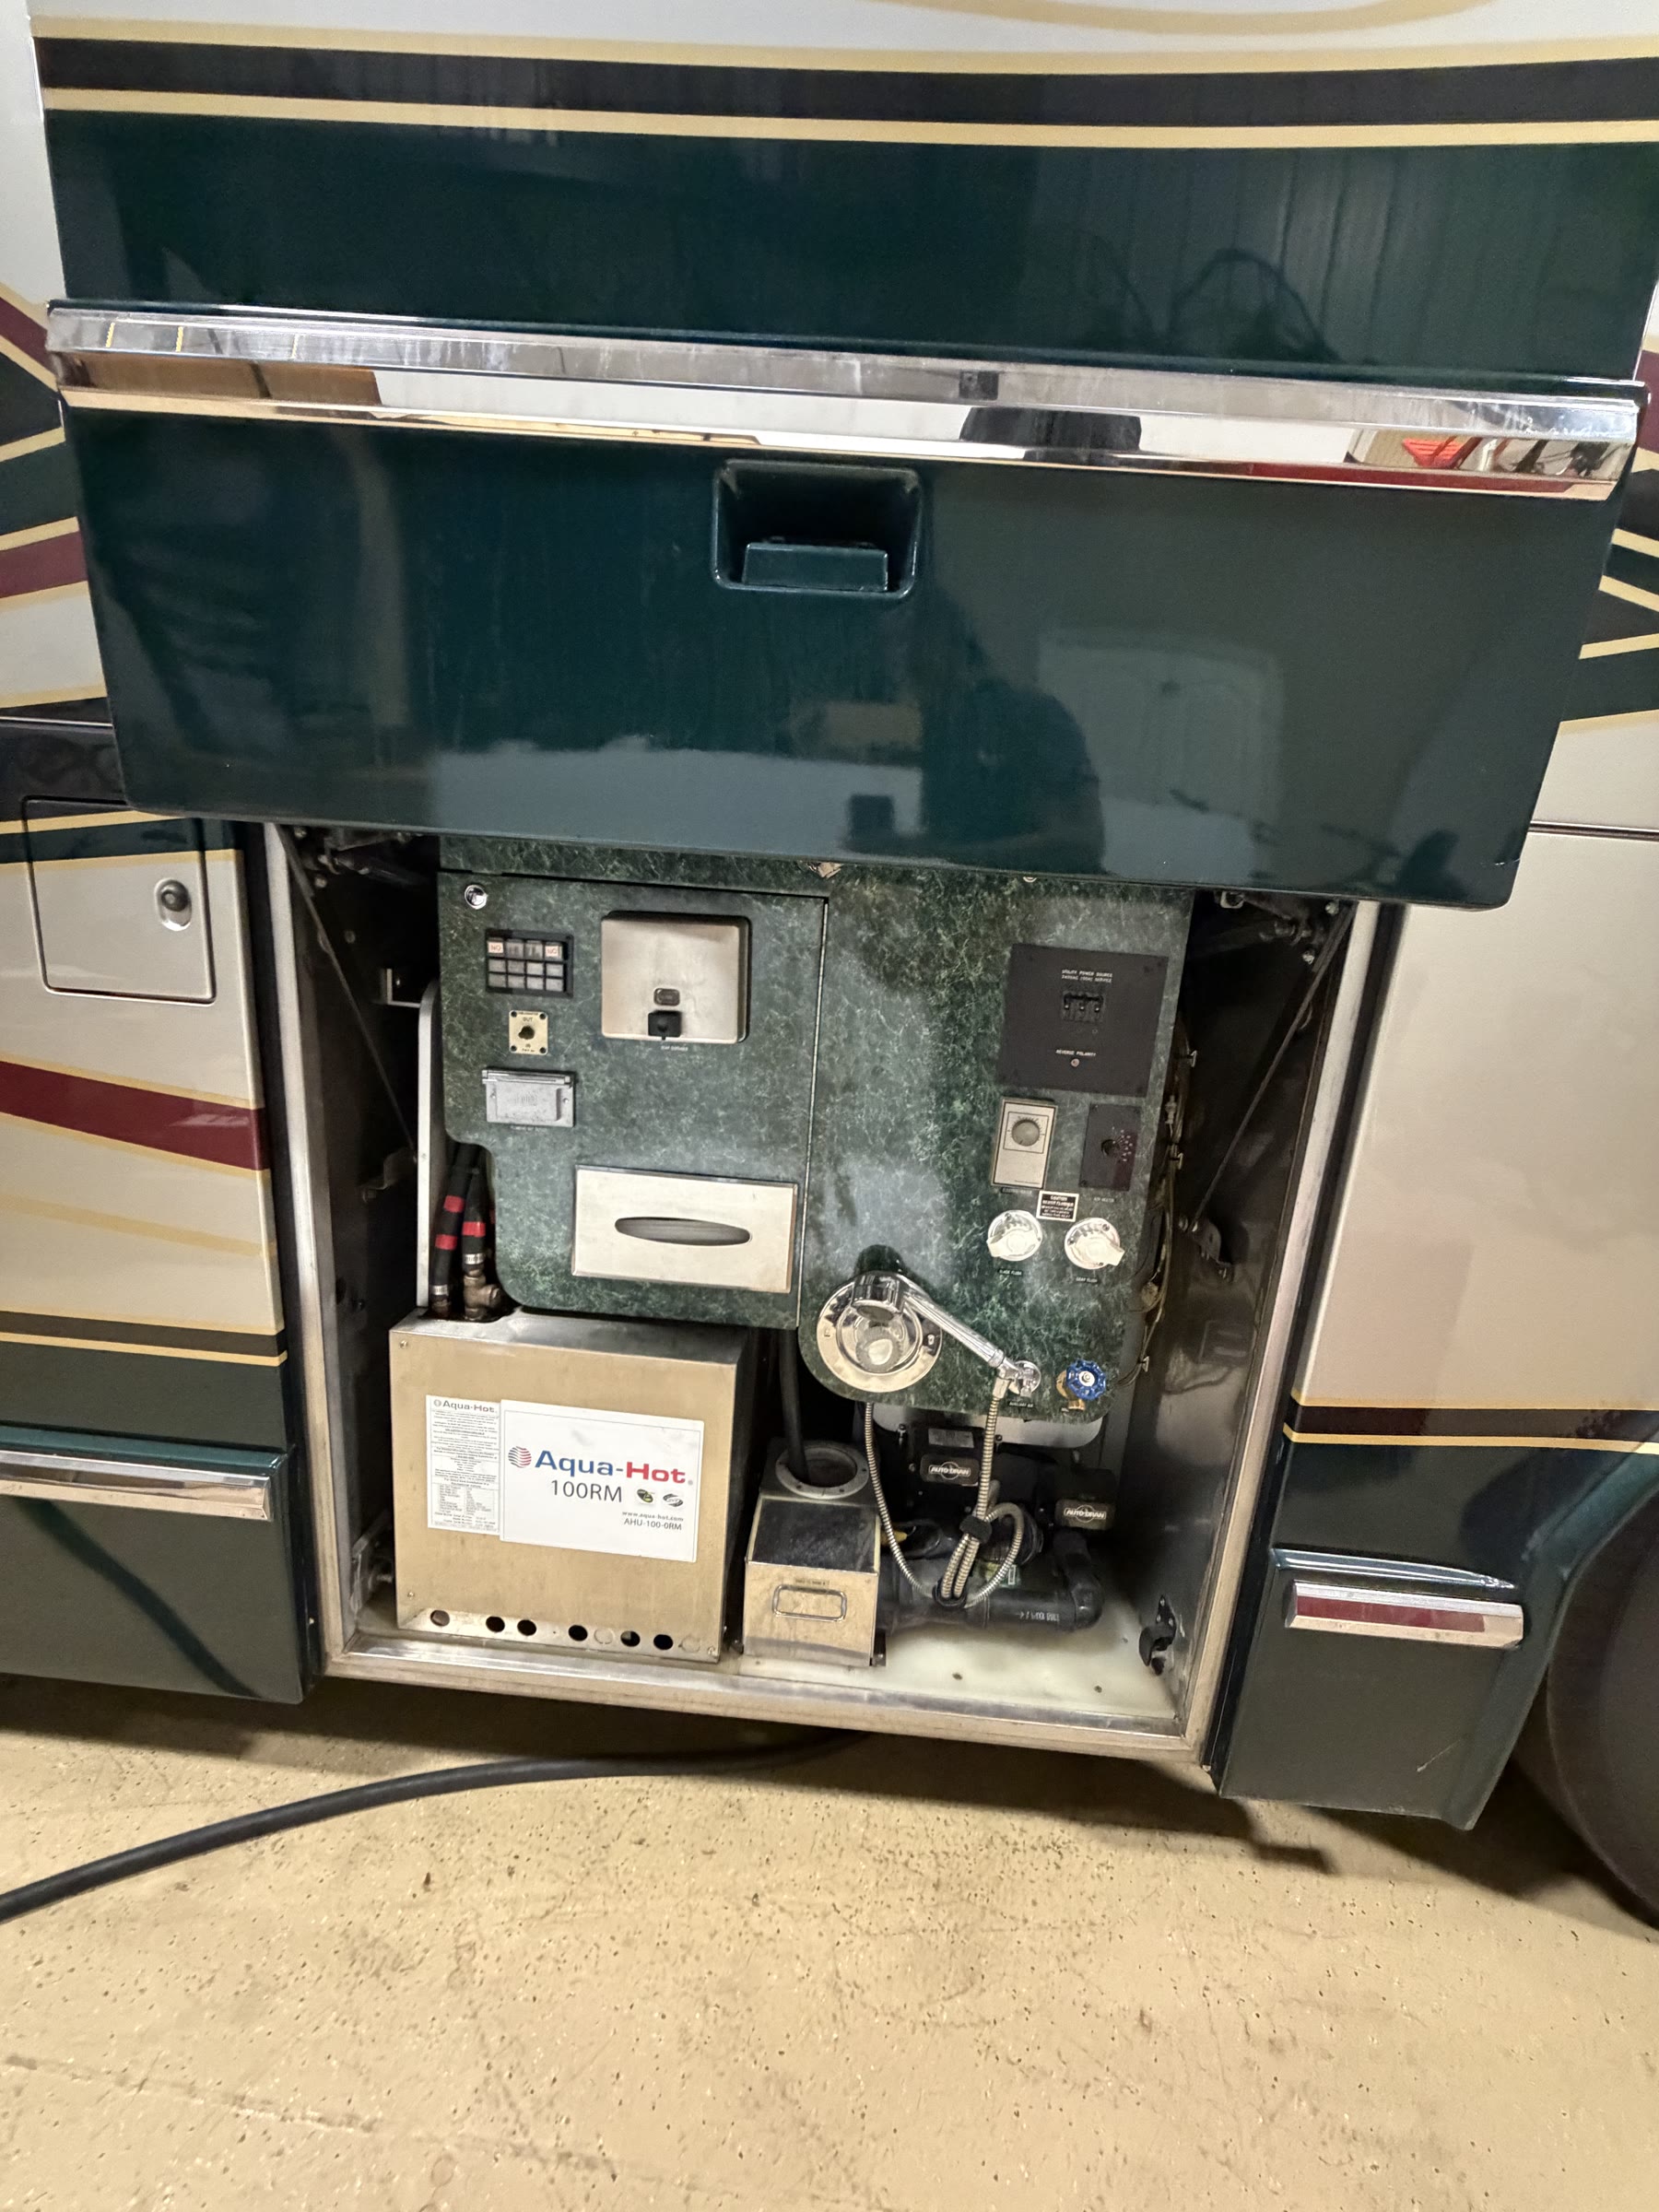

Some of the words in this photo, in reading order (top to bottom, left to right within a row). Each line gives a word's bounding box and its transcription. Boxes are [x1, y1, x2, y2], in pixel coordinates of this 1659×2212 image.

[442, 1400, 495, 1413] Aqua-Hot
[535, 1450, 687, 1484] Aqua-Hot
[550, 1479, 622, 1503] 100RM
[622, 1512, 684, 1522] www.aqua-hot.com
[623, 1518, 682, 1531] AHU-100-0RM
